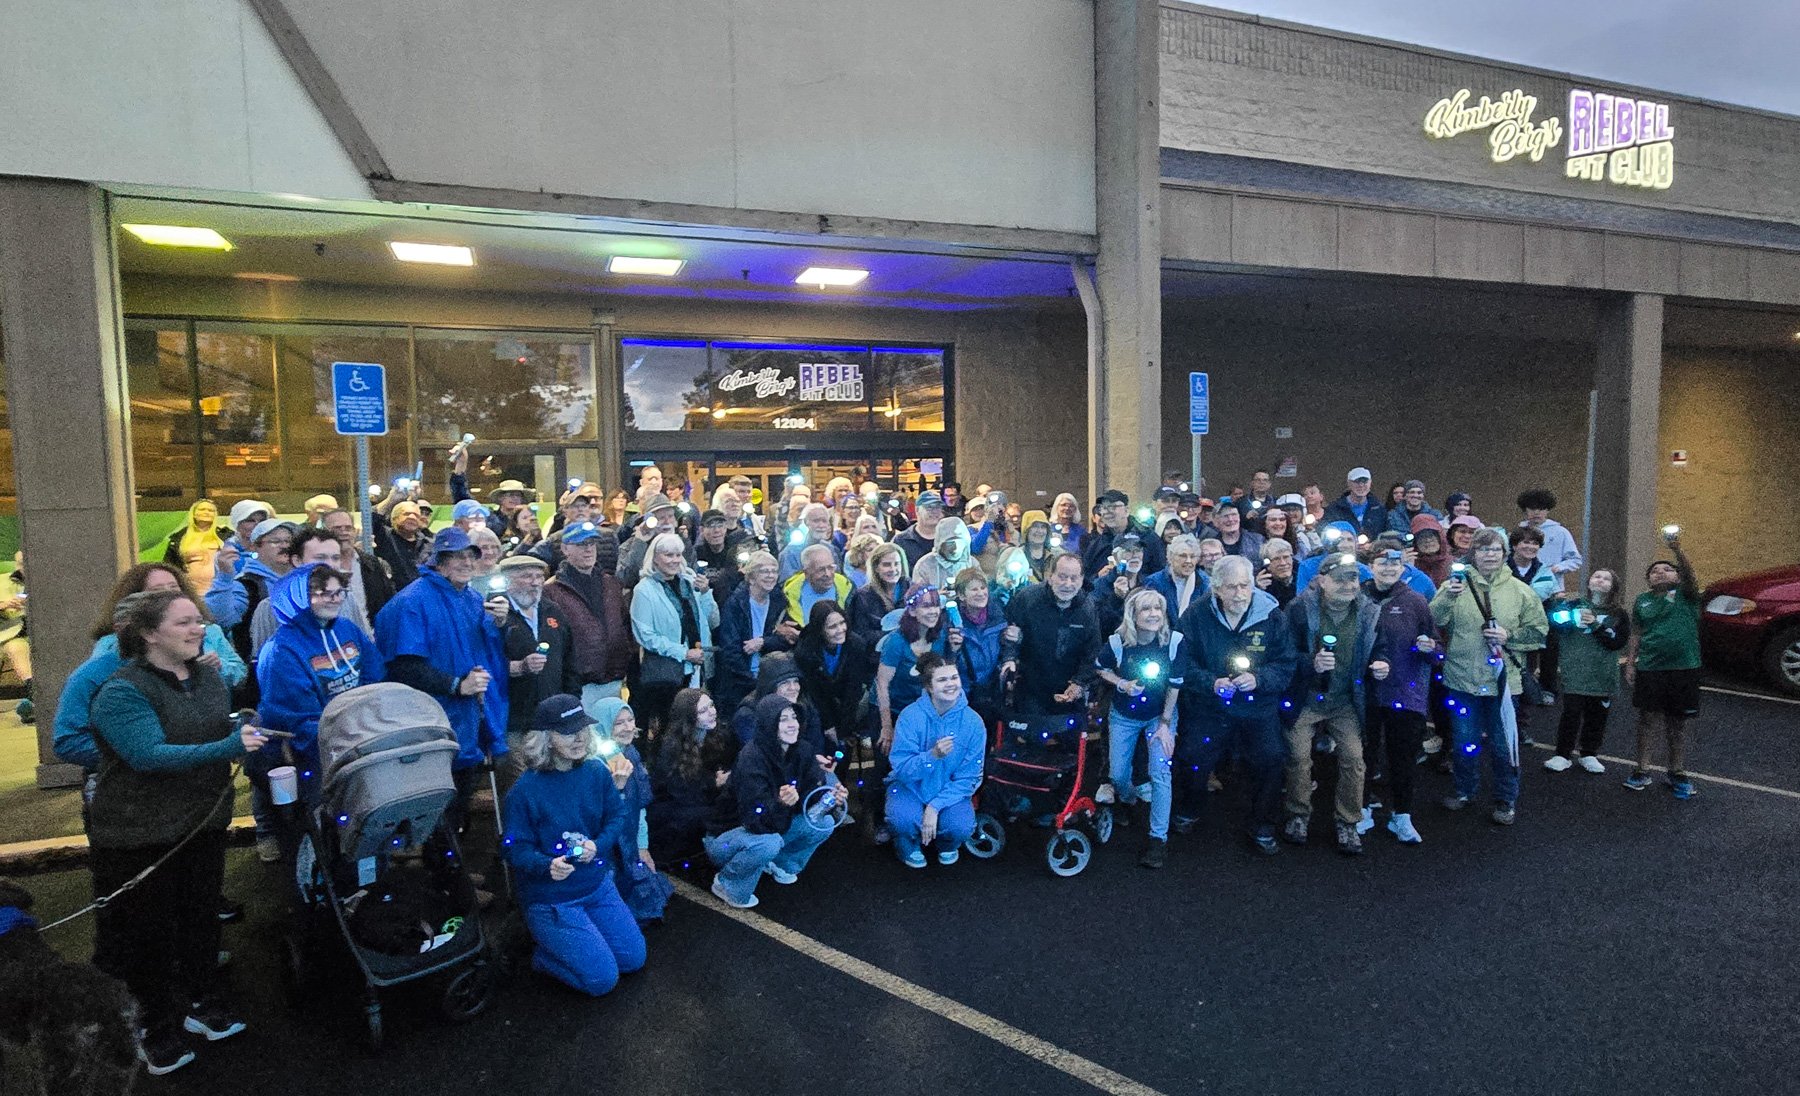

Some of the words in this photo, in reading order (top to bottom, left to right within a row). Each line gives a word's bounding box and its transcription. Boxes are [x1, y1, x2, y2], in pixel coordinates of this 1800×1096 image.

[1424, 88, 1537, 138] Kimberly
[1569, 89, 1674, 157] REBEL
[1567, 152, 1608, 181] FIT
[1609, 141, 1674, 189] CLUB
[718, 367, 781, 391] Kimberly
[800, 363, 863, 391] REBEL
[800, 389, 824, 401] FIT
[825, 381, 863, 401] CLUB
